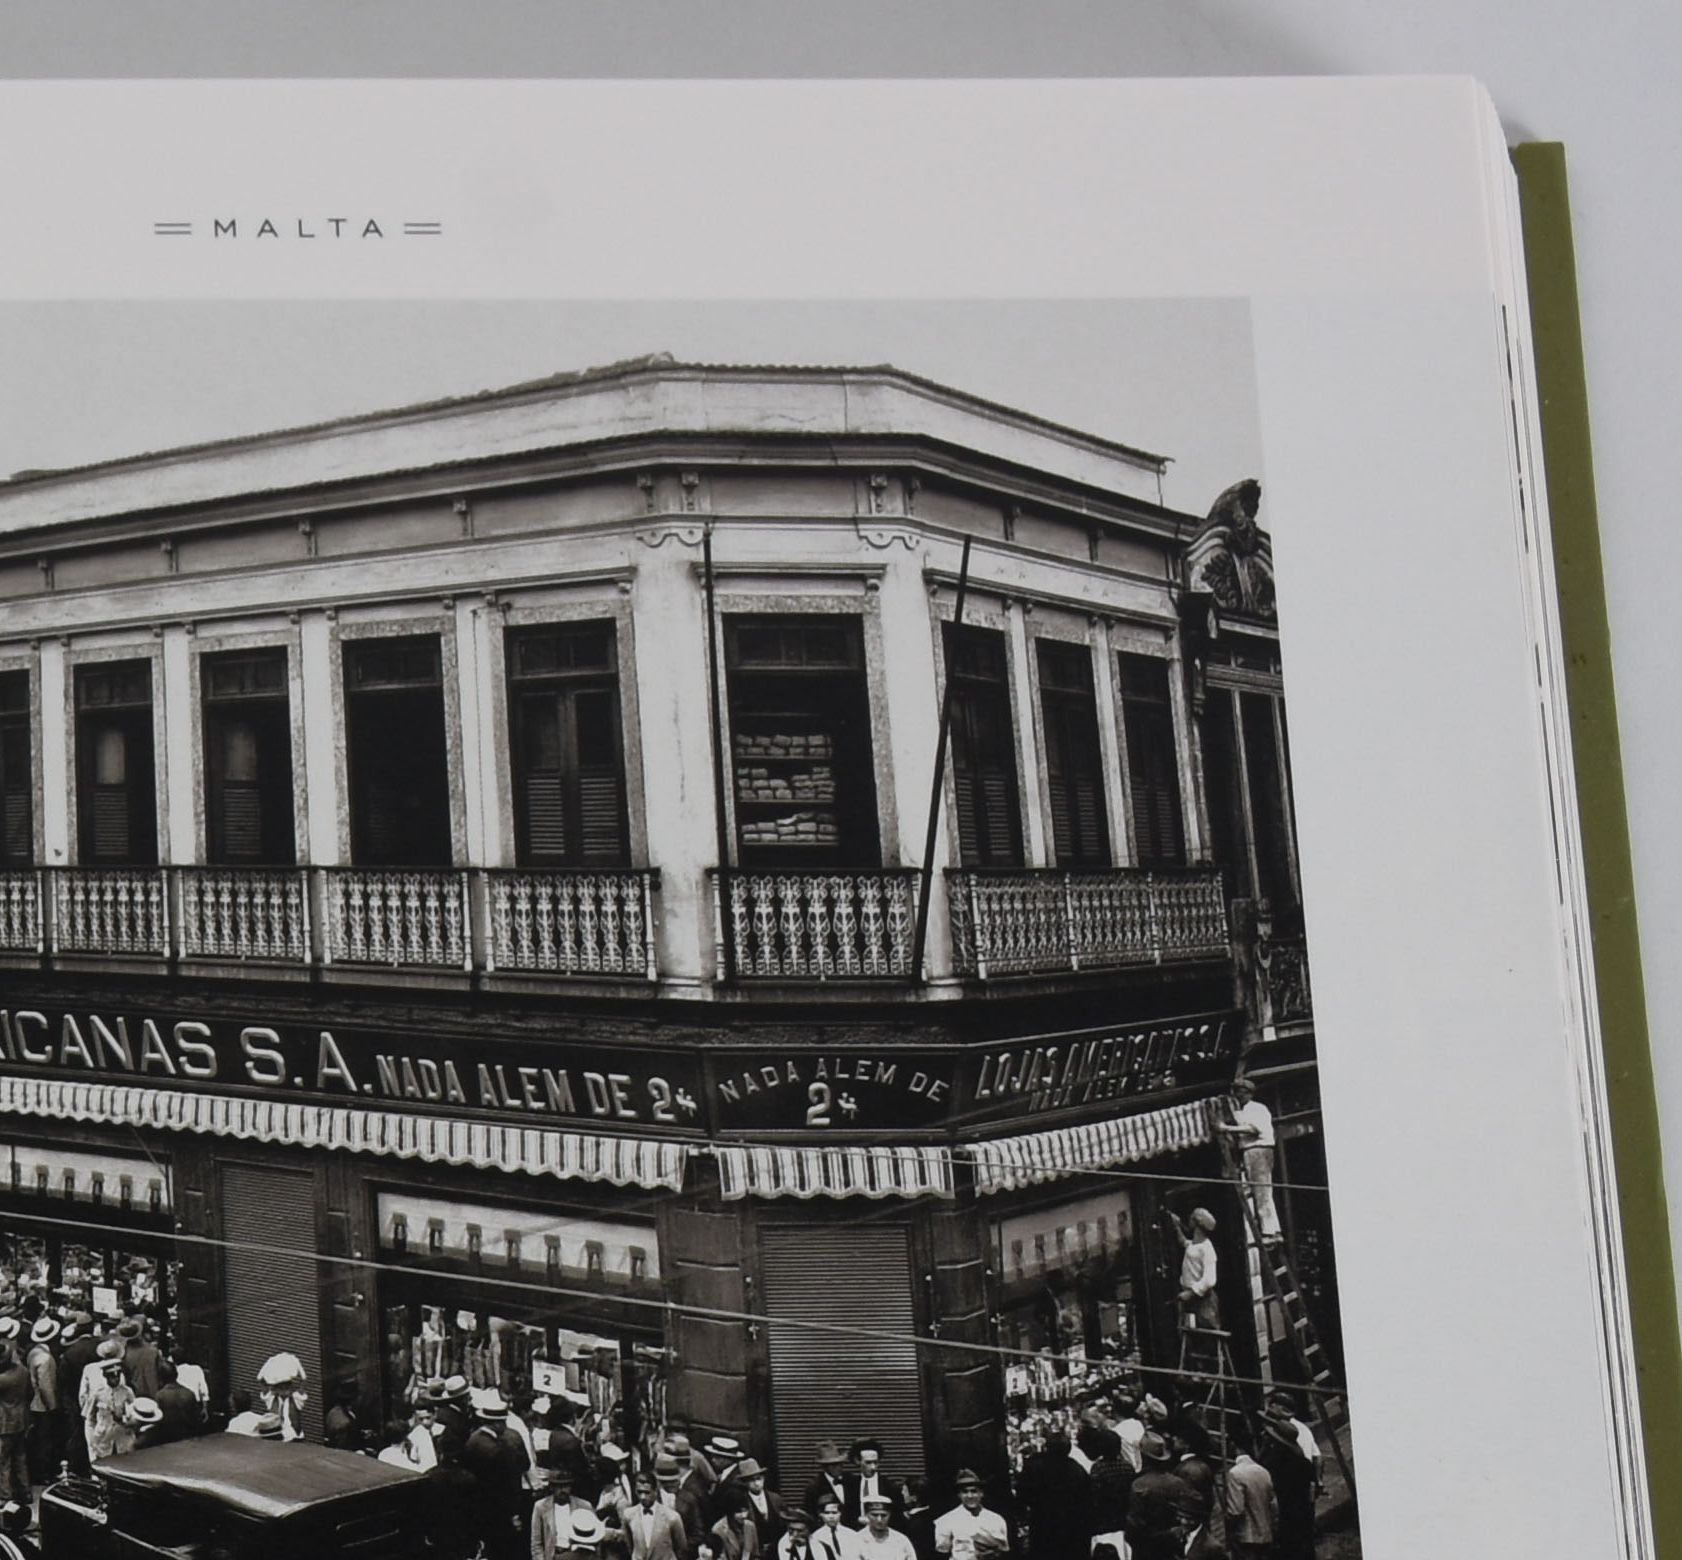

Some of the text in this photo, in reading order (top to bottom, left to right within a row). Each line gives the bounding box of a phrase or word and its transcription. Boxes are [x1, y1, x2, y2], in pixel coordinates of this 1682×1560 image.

[213, 217, 384, 239] MALTA
[241, 1026, 373, 1093] S.A.
[376, 1055, 465, 1104] NADA
[478, 1064, 575, 1113] ALEM
[584, 1071, 637, 1119] DE
[719, 1057, 950, 1103] NADA ALEM DE
